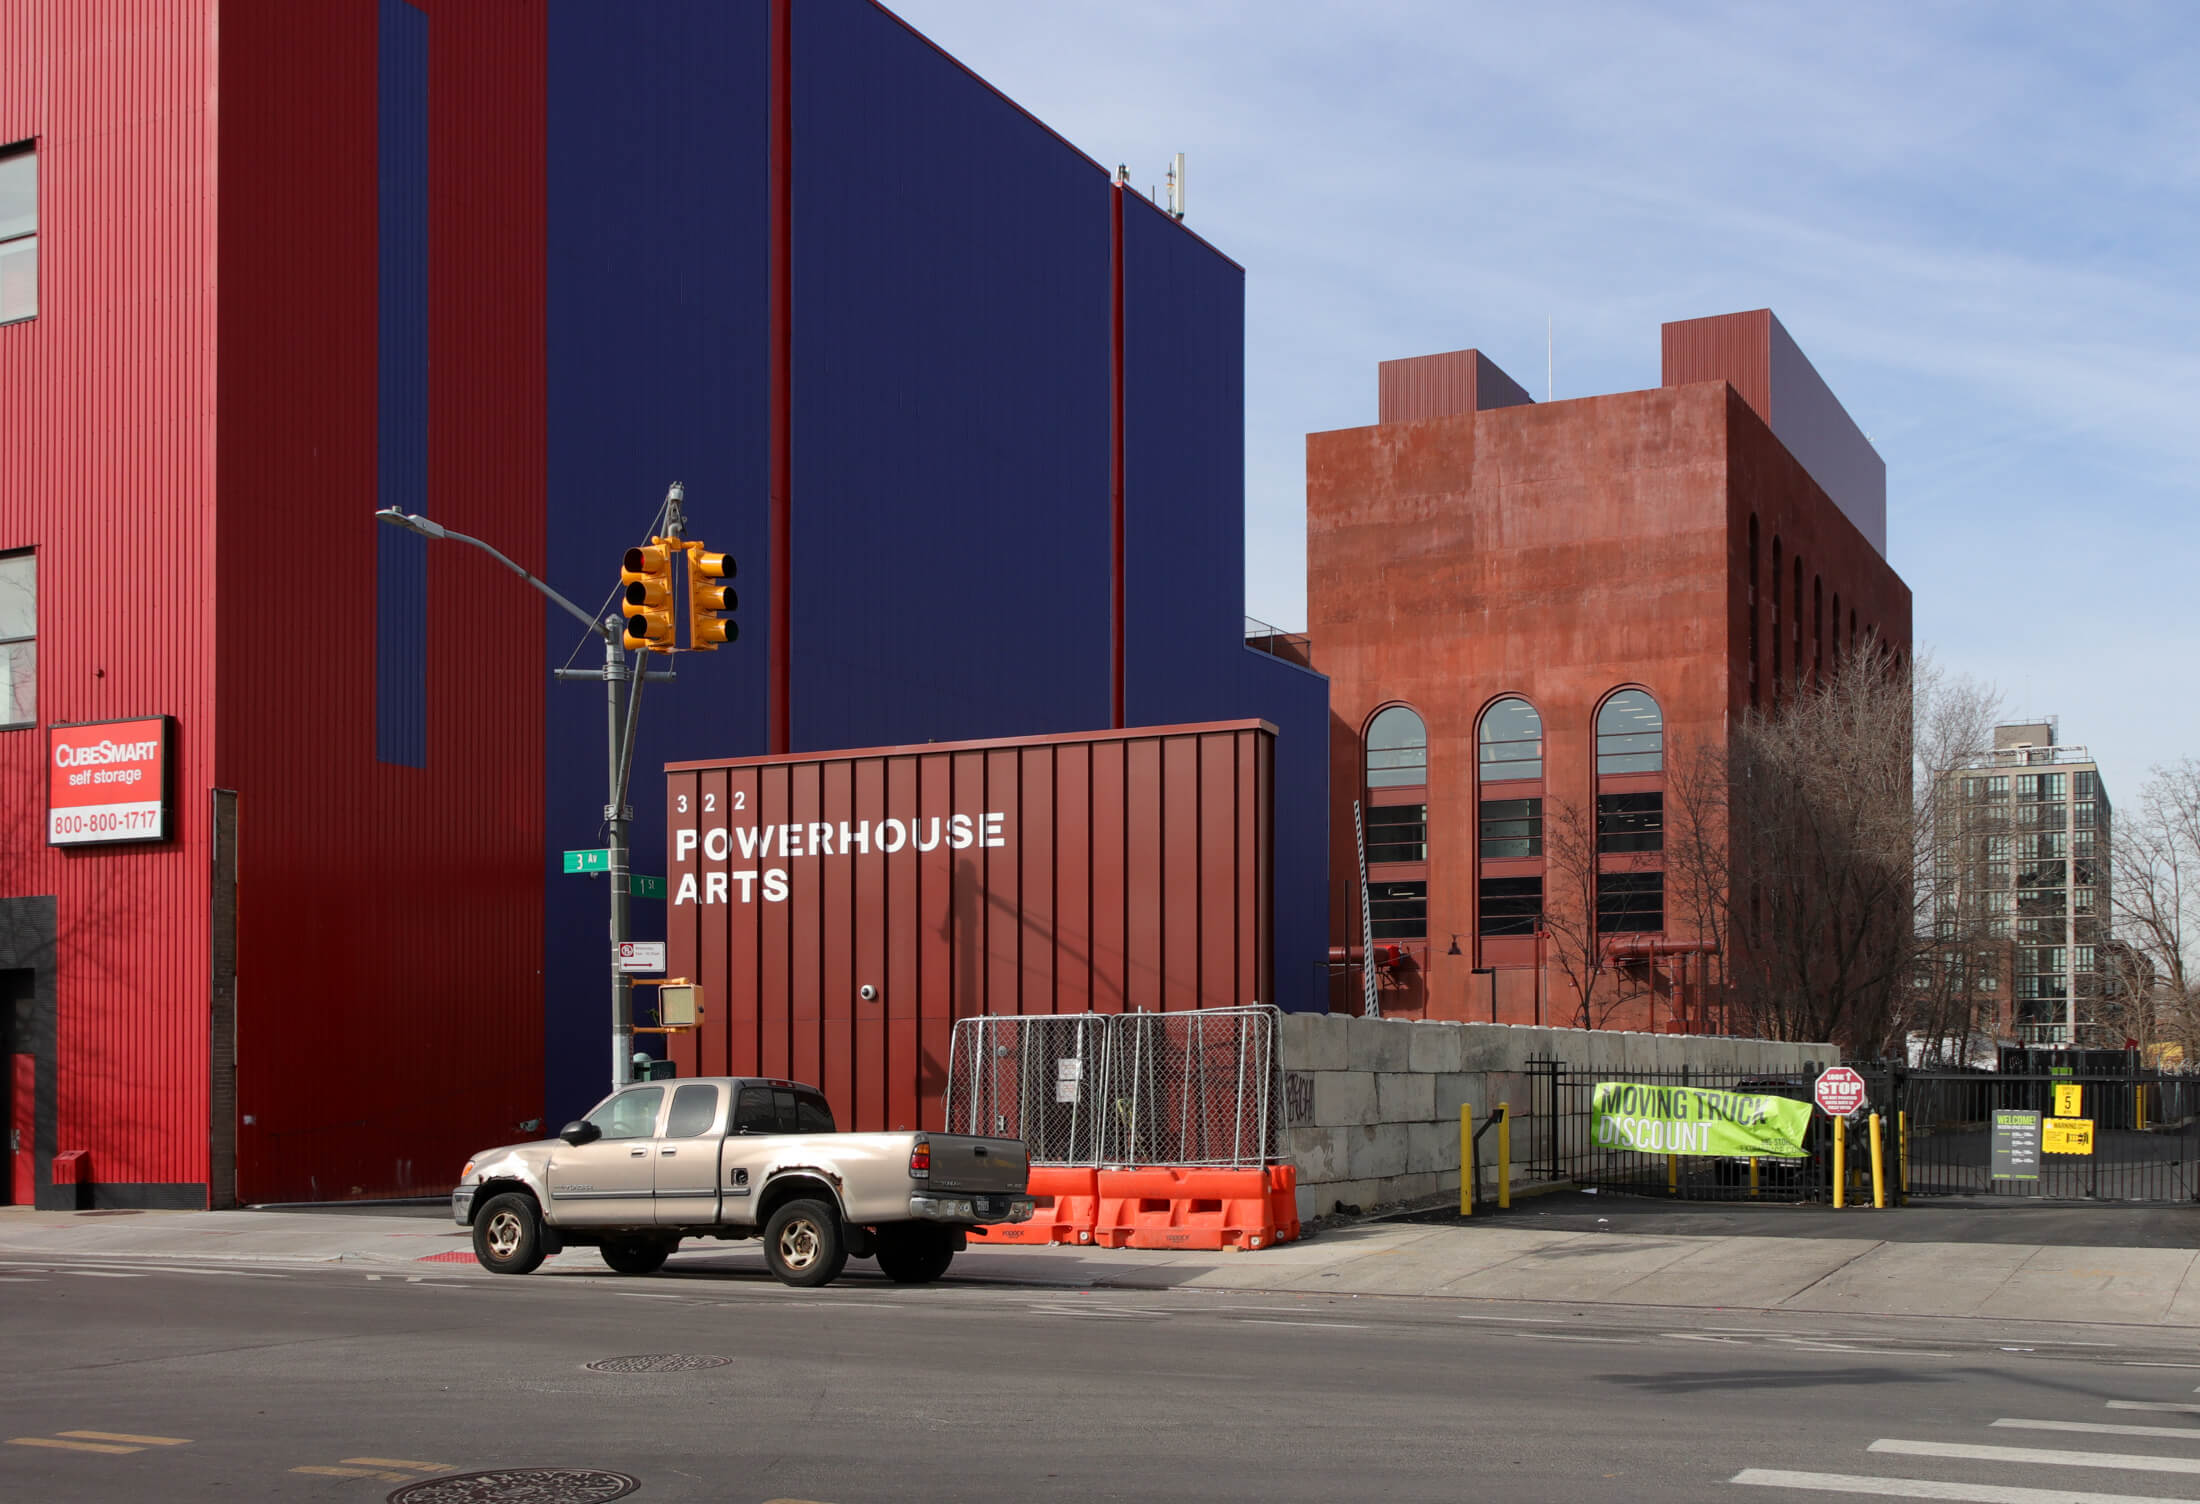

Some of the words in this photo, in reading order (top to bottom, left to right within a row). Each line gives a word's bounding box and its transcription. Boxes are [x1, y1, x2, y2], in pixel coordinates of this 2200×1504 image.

[55, 739, 158, 768] CUBESMART
[68, 769, 92, 786] self
[93, 768, 142, 785] storage
[55, 810, 157, 834] 800-800-1717
[676, 812, 1006, 862] POWERHOUSE
[576, 853, 584, 870] 3
[640, 878, 645, 895] 1
[674, 868, 790, 906] ARTS
[1818, 1081, 1862, 1096] STOP
[1600, 1085, 1688, 1120] MOVING
[1693, 1091, 1767, 1126] TRUCK
[2064, 1095, 2072, 1110] 5
[1598, 1115, 1713, 1153] DISCOUNT
